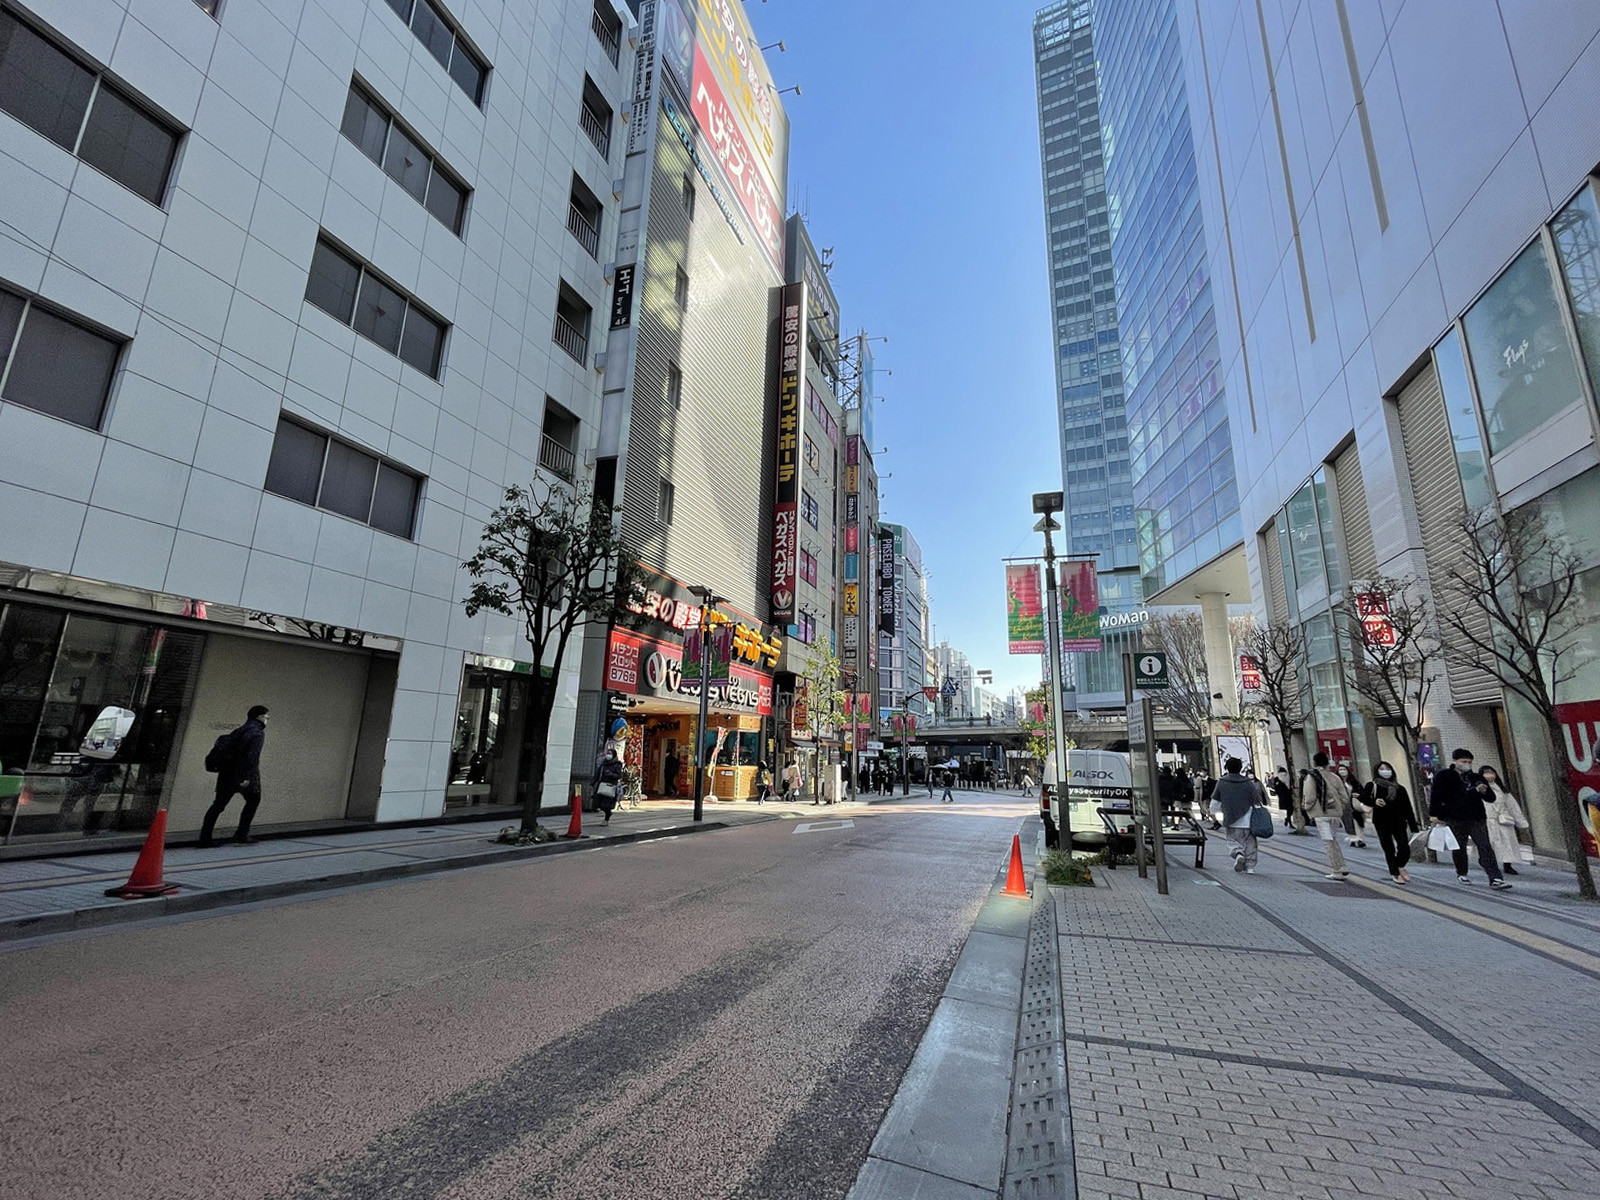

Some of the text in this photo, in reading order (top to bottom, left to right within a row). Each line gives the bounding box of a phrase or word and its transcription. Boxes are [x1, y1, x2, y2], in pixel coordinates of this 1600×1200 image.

[696, 82, 784, 265] ベガスベガス
[773, 511, 789, 587] ベガスベガス
[882, 538, 893, 614] PASELABO TOWER
[612, 641, 639, 658] パチンコ
[611, 653, 636, 669] スロット
[611, 668, 635, 683] 876台
[722, 685, 760, 707] VEGAS
[1073, 769, 1114, 780] ALSOK
